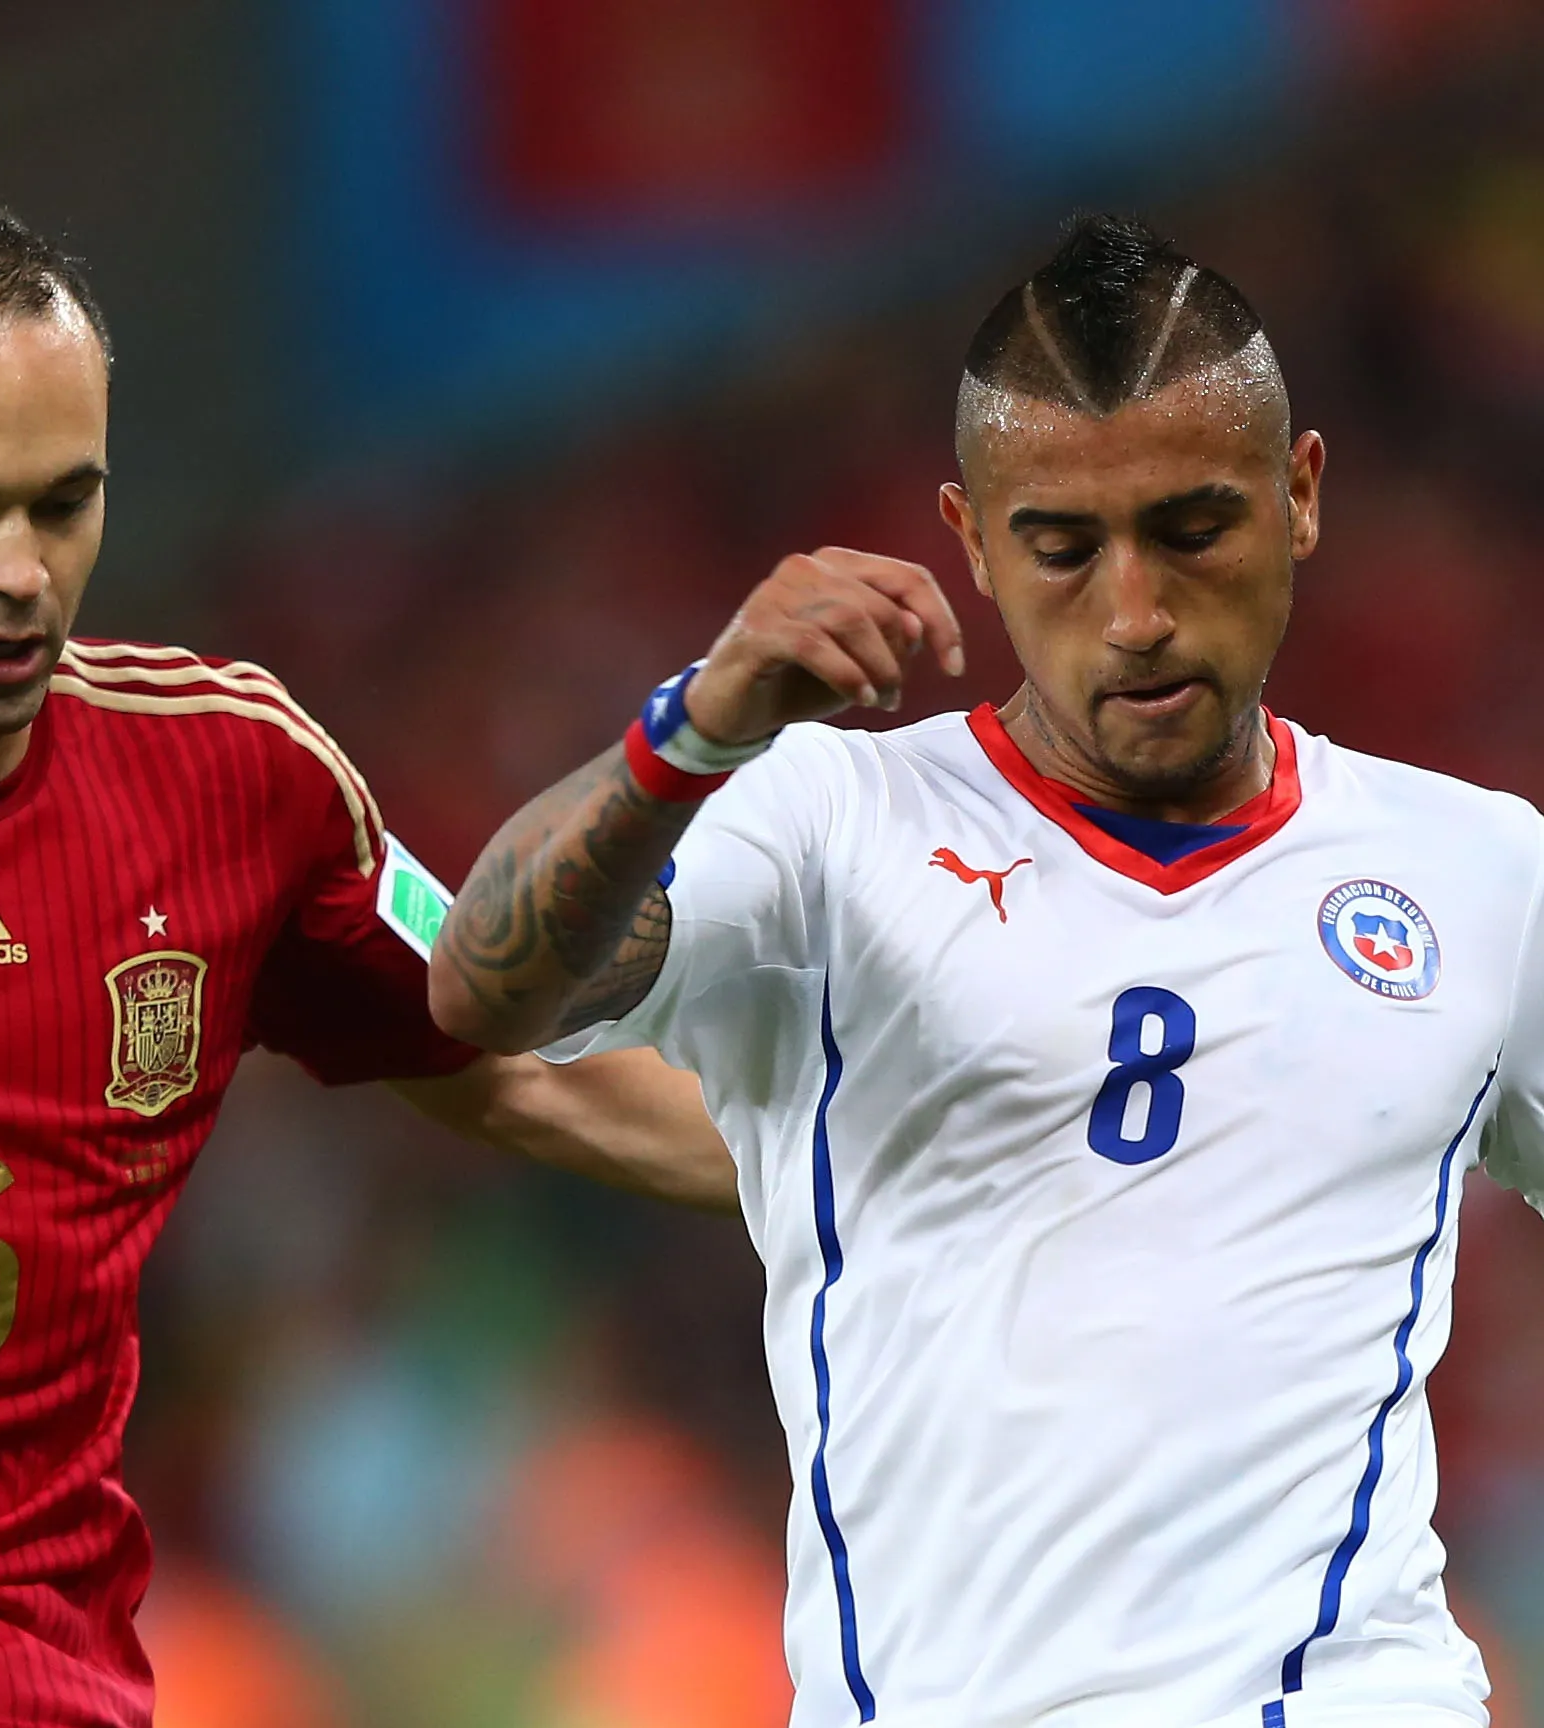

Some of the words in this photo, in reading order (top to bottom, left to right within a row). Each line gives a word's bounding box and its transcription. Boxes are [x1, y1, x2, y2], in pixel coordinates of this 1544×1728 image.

[1322, 882, 1382, 925] FEDERACION
[1385, 889, 1401, 905] DE
[1360, 973, 1378, 990] DE
[1381, 982, 1417, 998] CHILE
[1087, 986, 1196, 1166] 8
